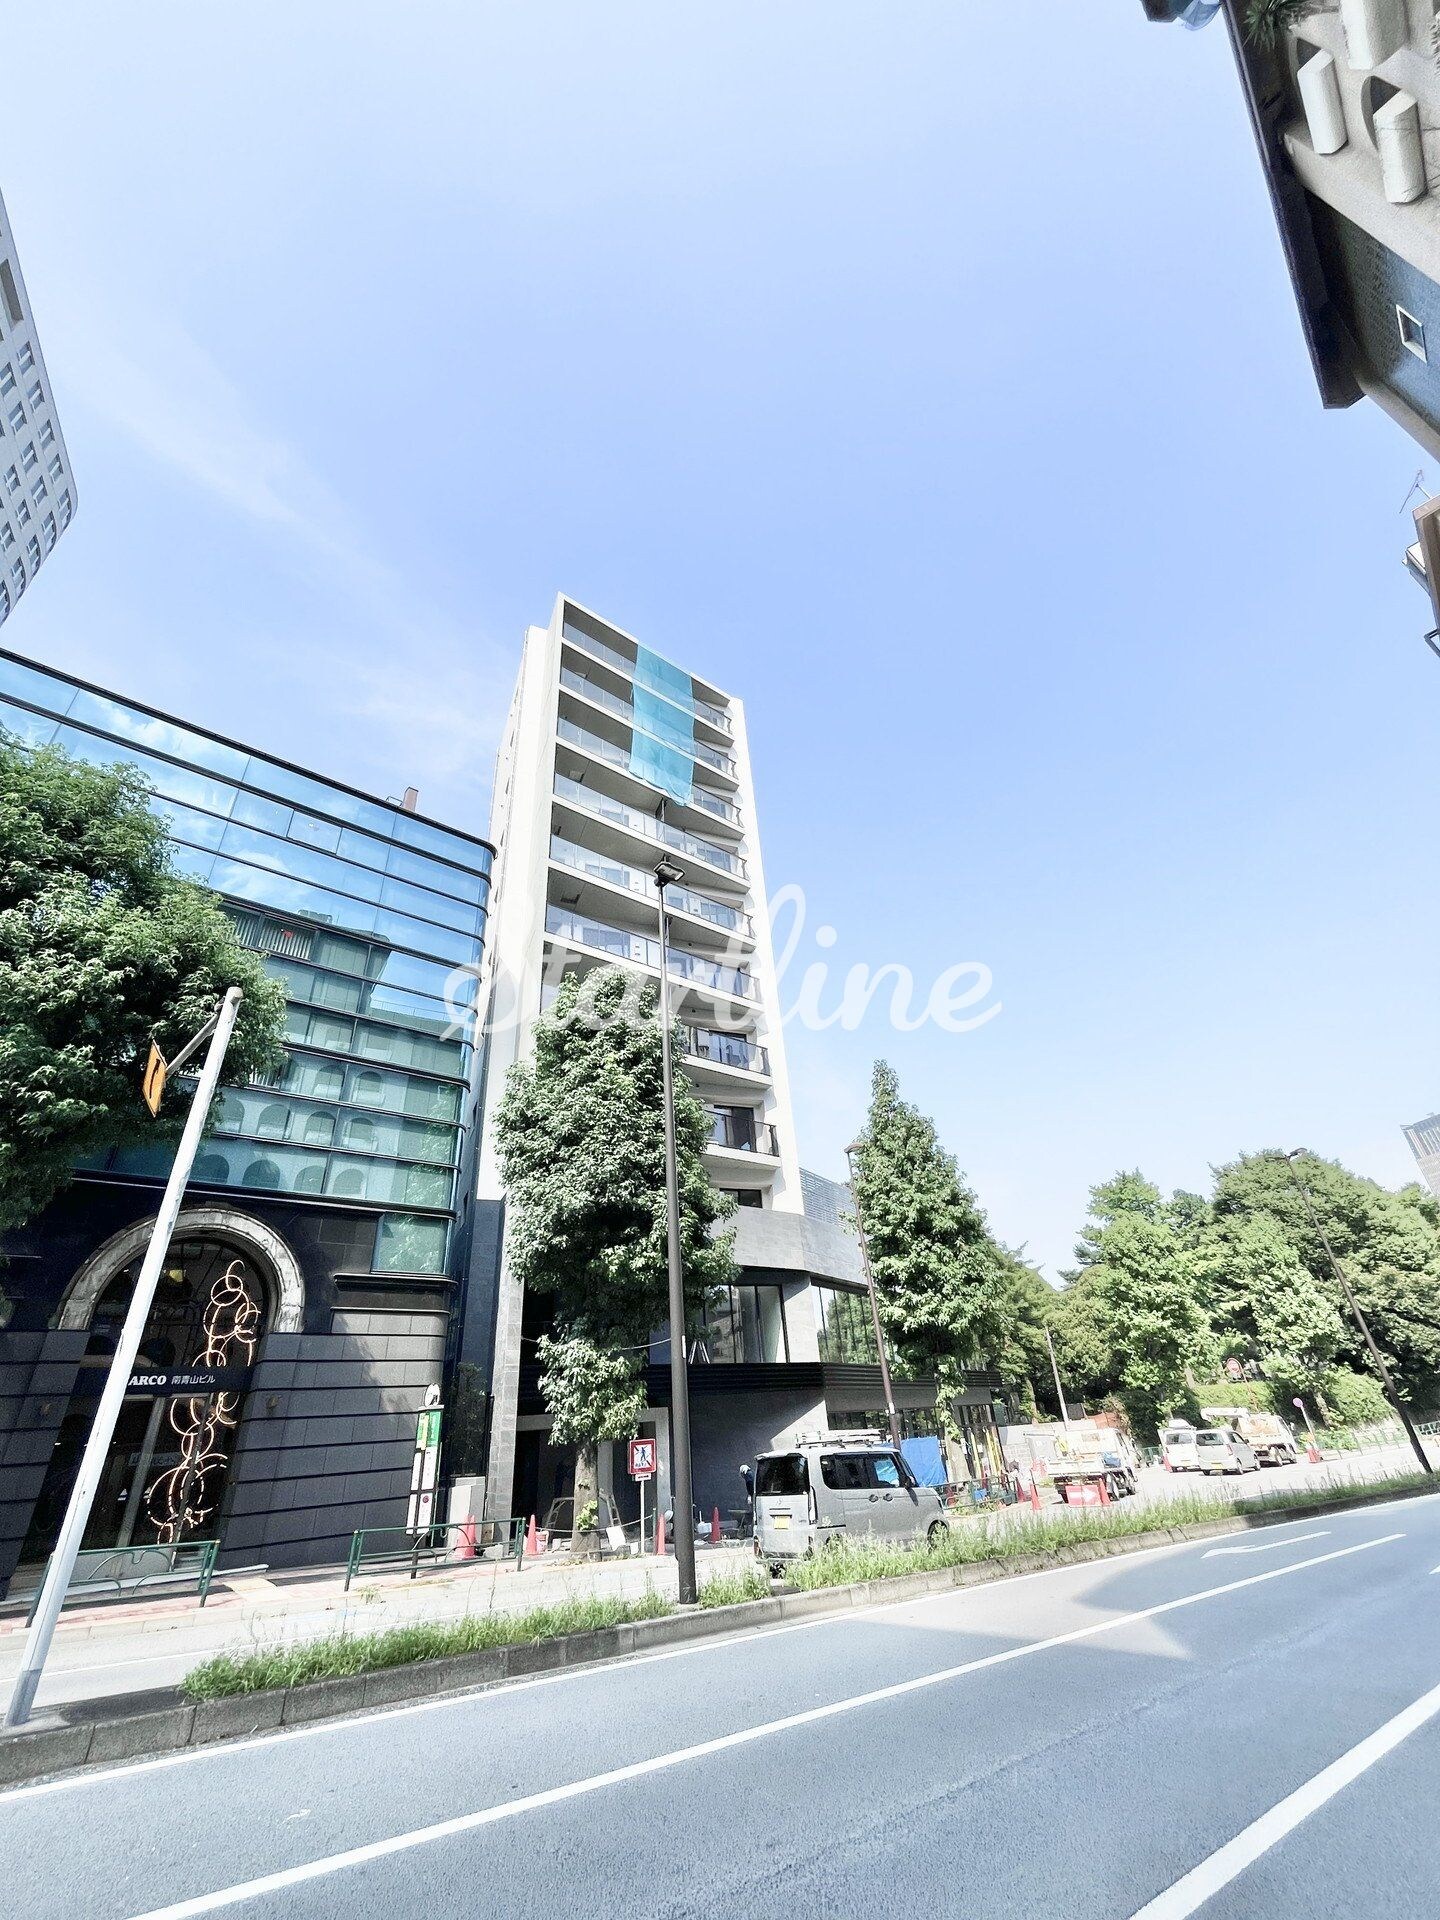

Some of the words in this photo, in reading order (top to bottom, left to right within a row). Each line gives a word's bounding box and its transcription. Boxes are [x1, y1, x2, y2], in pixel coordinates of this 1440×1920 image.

[171, 1374, 216, 1385] 南青山ビル
